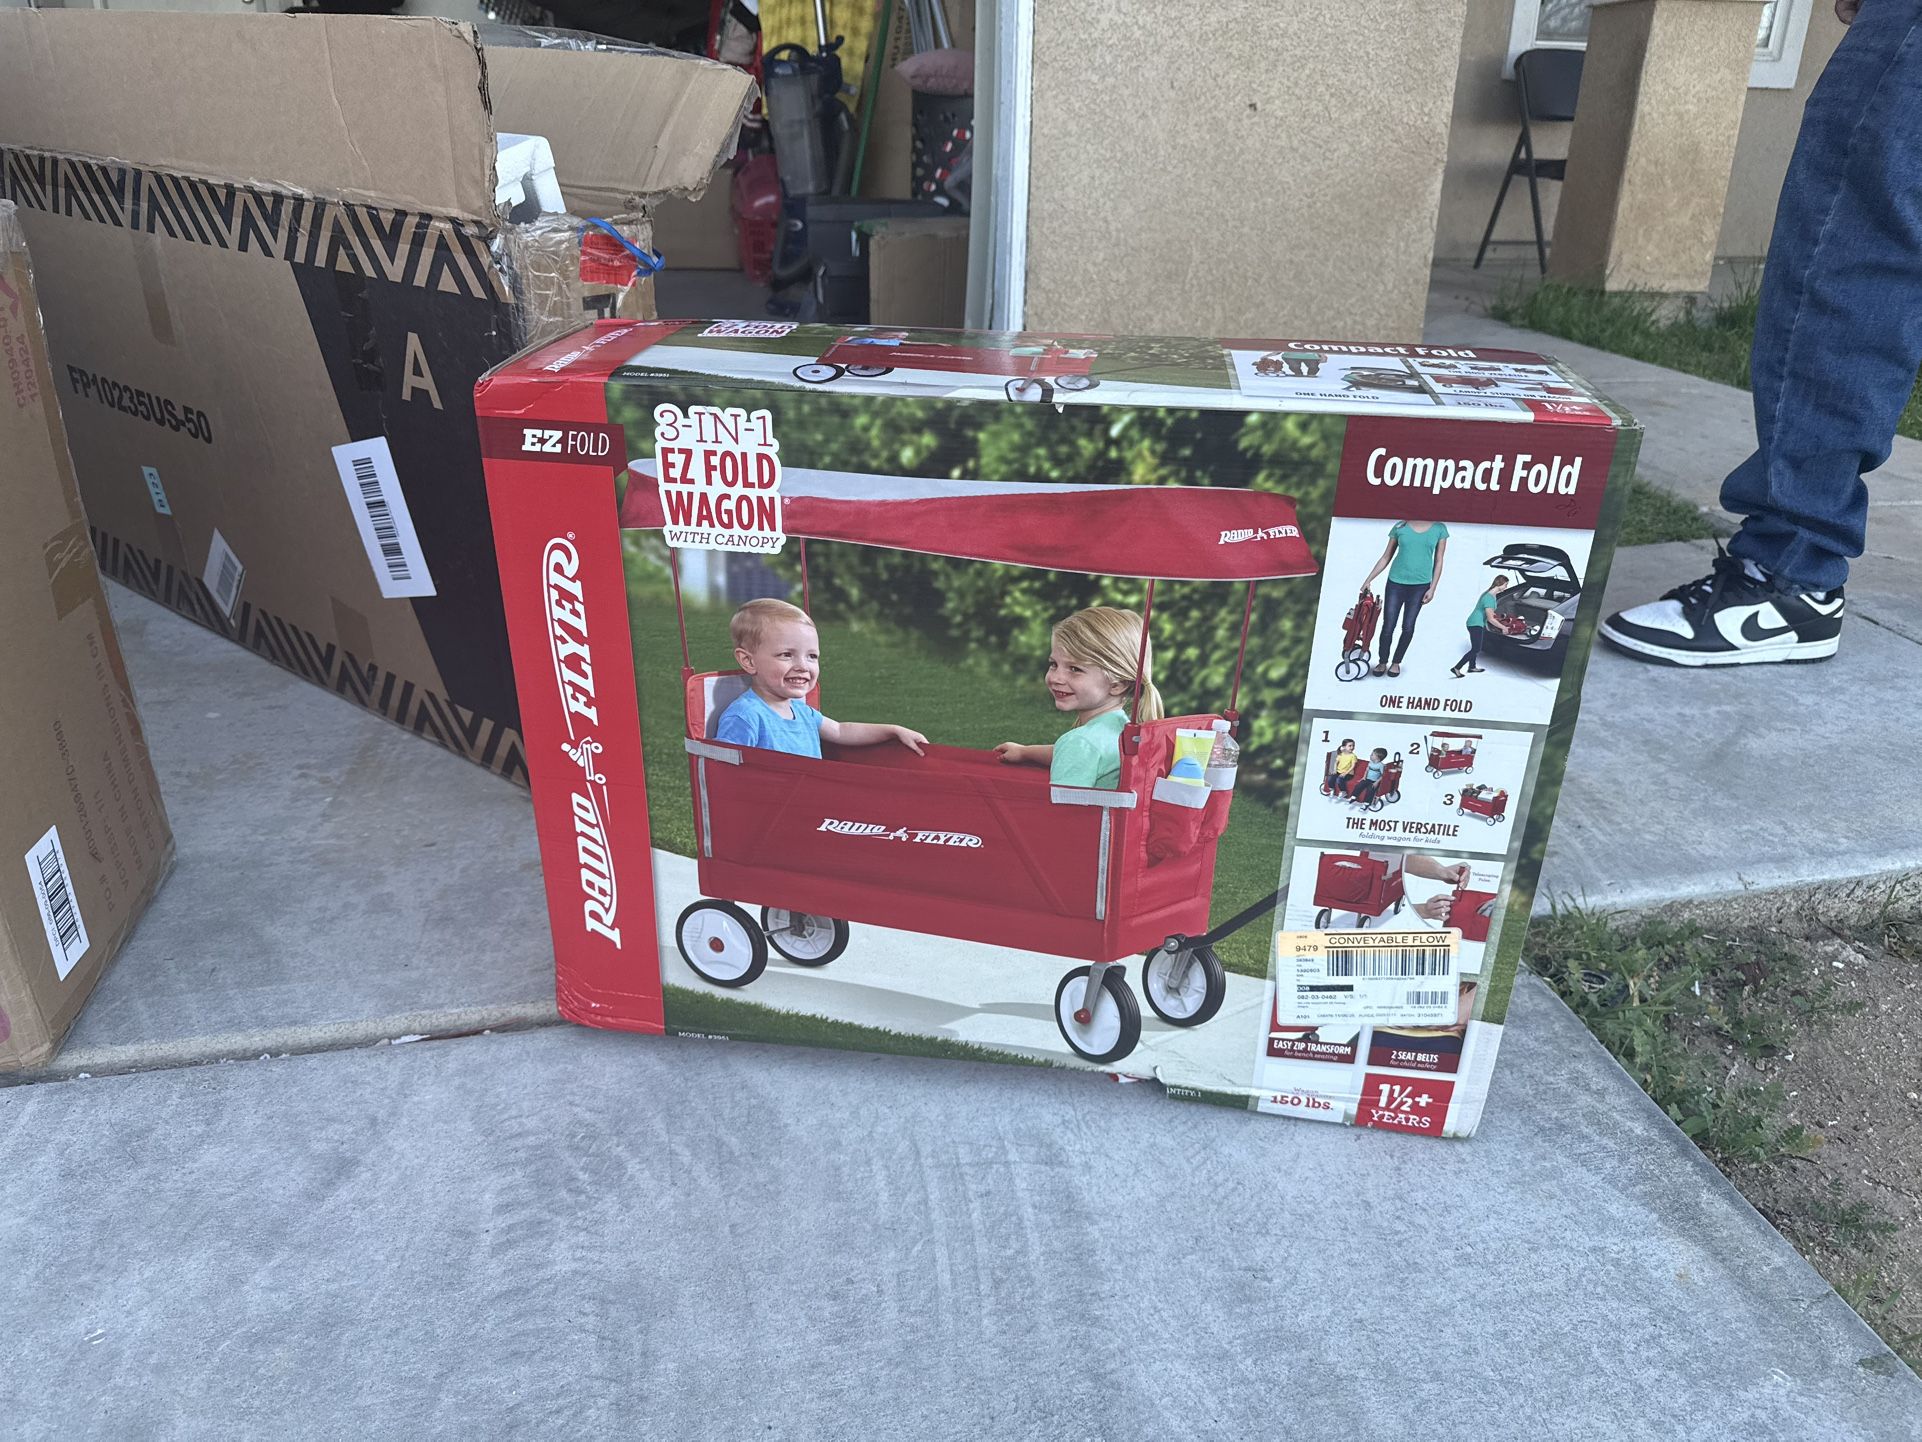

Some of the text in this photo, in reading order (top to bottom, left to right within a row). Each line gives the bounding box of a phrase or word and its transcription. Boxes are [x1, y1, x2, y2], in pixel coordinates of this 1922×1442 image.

[1287, 341, 1477, 359] Compact Fold
[401, 331, 444, 410] A
[543, 350, 582, 373] RADIO
[66, 364, 213, 445] FP10235US-50
[658, 408, 774, 448] 3-IN-1
[522, 428, 610, 456] EZ FOLD
[660, 447, 777, 490] EZ FOLD
[1365, 446, 1583, 496] Compact Fold
[664, 489, 777, 532] WAGON
[668, 529, 781, 549] WITH CANOPY
[1218, 524, 1300, 545] RADIO FLYER
[1380, 694, 1473, 713] ONE HAND FOLD
[542, 535, 623, 950] RADIO FLYER
[1321, 730, 1331, 743] 1
[1408, 742, 1421, 755] 2
[1442, 793, 1454, 806] 3
[816, 817, 983, 848] RADIO FLYER
[1345, 816, 1460, 837] THE MOST VERSATILE
[1358, 831, 1441, 845] folding wagon for kids
[1295, 944, 1319, 952] 9479
[1328, 935, 1448, 945] CONVEYABLE FLOW
[678, 1031, 706, 1039] MODEL
[1273, 1039, 1352, 1055] EASY ZIP TRANSFORM
[1293, 1051, 1312, 1059] bench
[1313, 1053, 1338, 1061] seating
[1391, 1050, 1439, 1063] 2 SEAT BELTS
[1389, 1059, 1438, 1070] for child safety
[1270, 1094, 1302, 1106] 150
[1304, 1096, 1334, 1111] lbs.
[1370, 1108, 1432, 1128] YEARS
